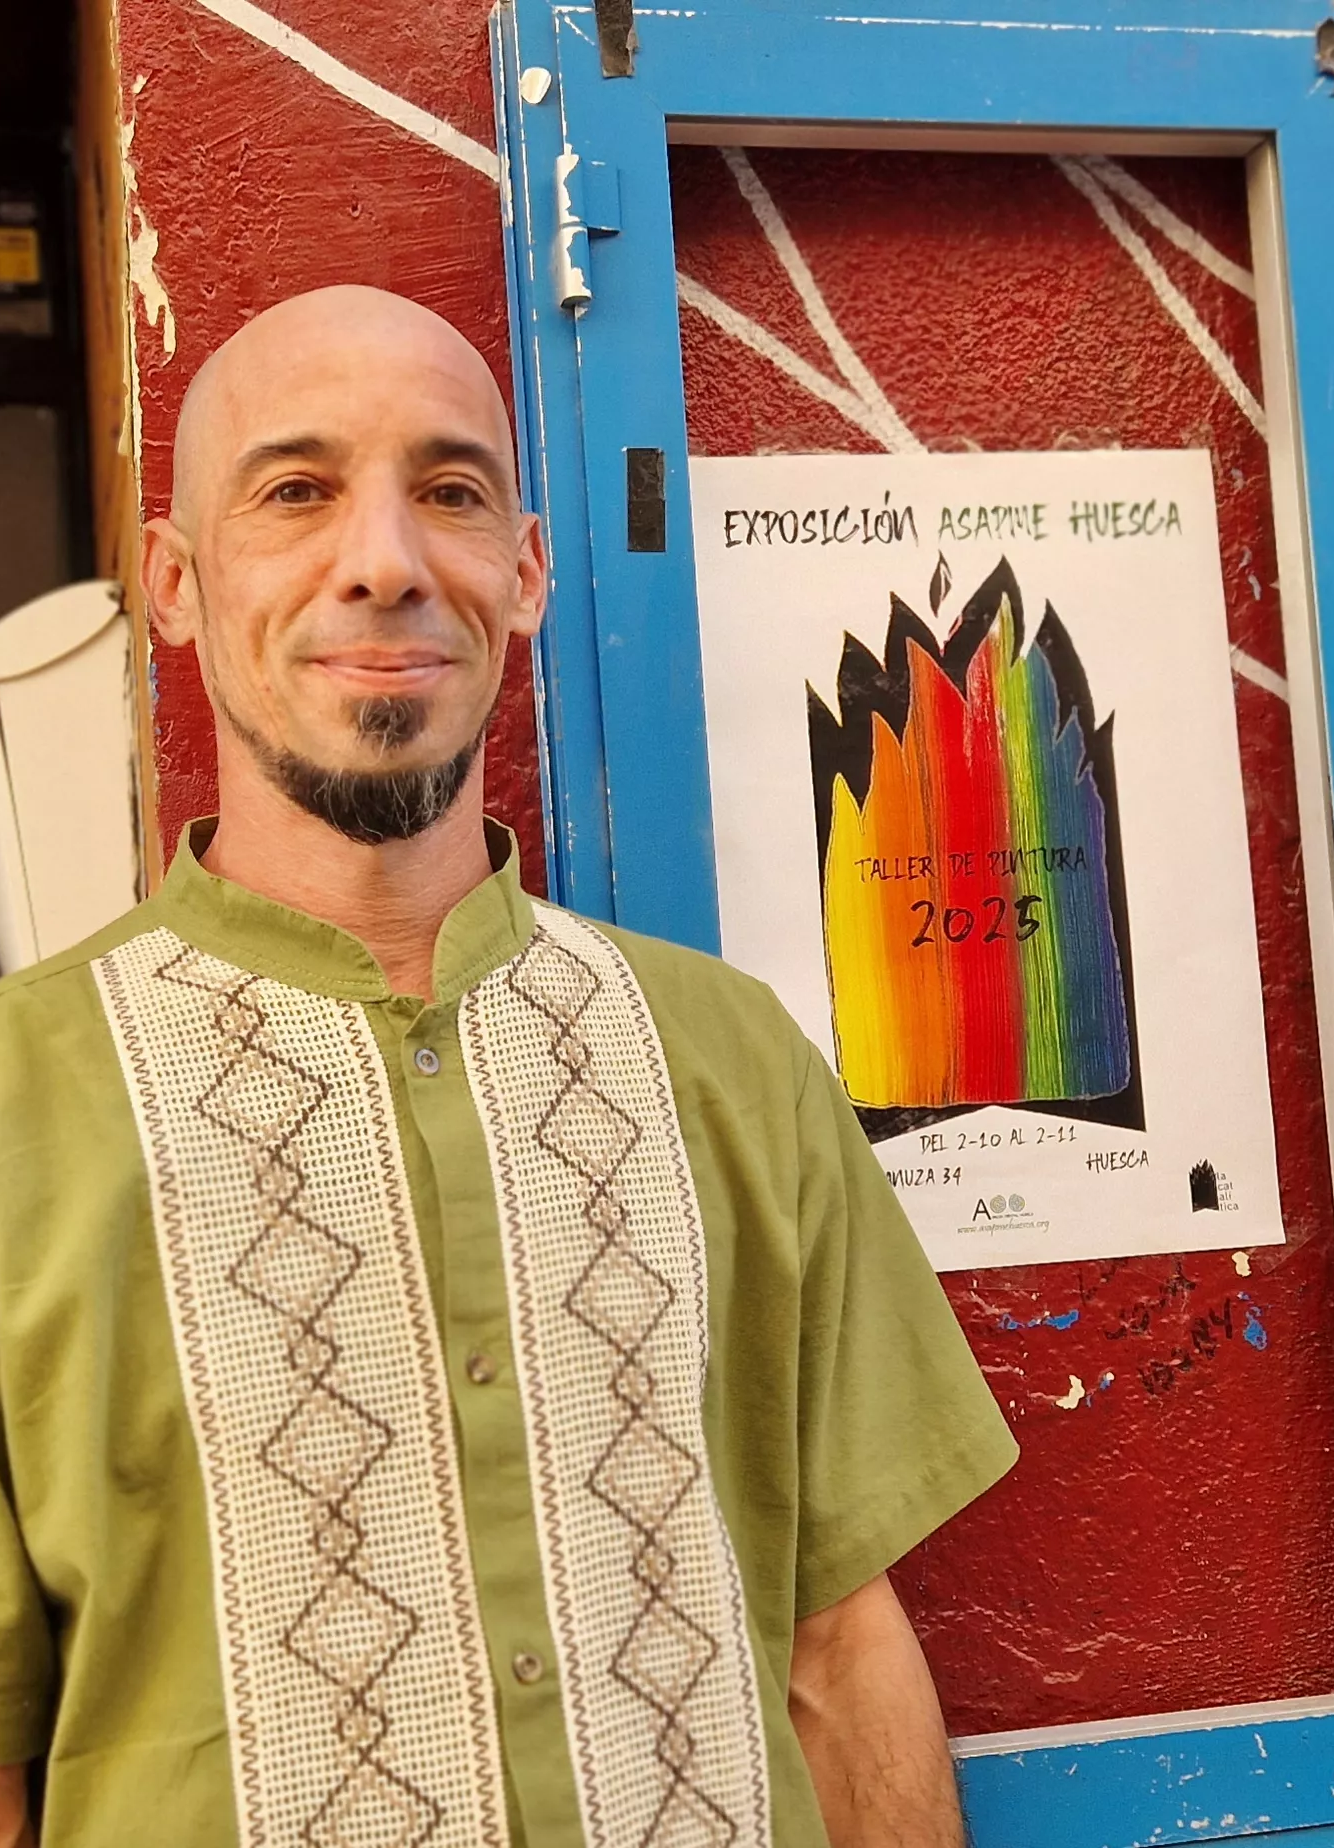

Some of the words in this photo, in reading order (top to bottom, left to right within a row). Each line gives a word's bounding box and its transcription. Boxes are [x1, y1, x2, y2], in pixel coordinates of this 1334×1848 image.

[723, 490, 919, 548] EXPOSICIÓN
[937, 502, 1050, 541] ASAPME
[1068, 499, 1182, 542] HUESCA
[855, 855, 936, 883] TALLER
[948, 851, 974, 880] DE
[988, 846, 1087, 877] PINTURA
[910, 894, 1043, 948] 2025
[919, 1133, 949, 1155] DEL
[958, 1131, 1003, 1151] 2-10
[1009, 1128, 1028, 1146] AL
[1036, 1125, 1078, 1144] 2-11
[1085, 1149, 1149, 1174] HUESCA
[942, 1166, 962, 1186] 34
[1216, 1171, 1227, 1181] la
[1217, 1181, 1234, 1191] cat
[1219, 1202, 1240, 1212] tica
